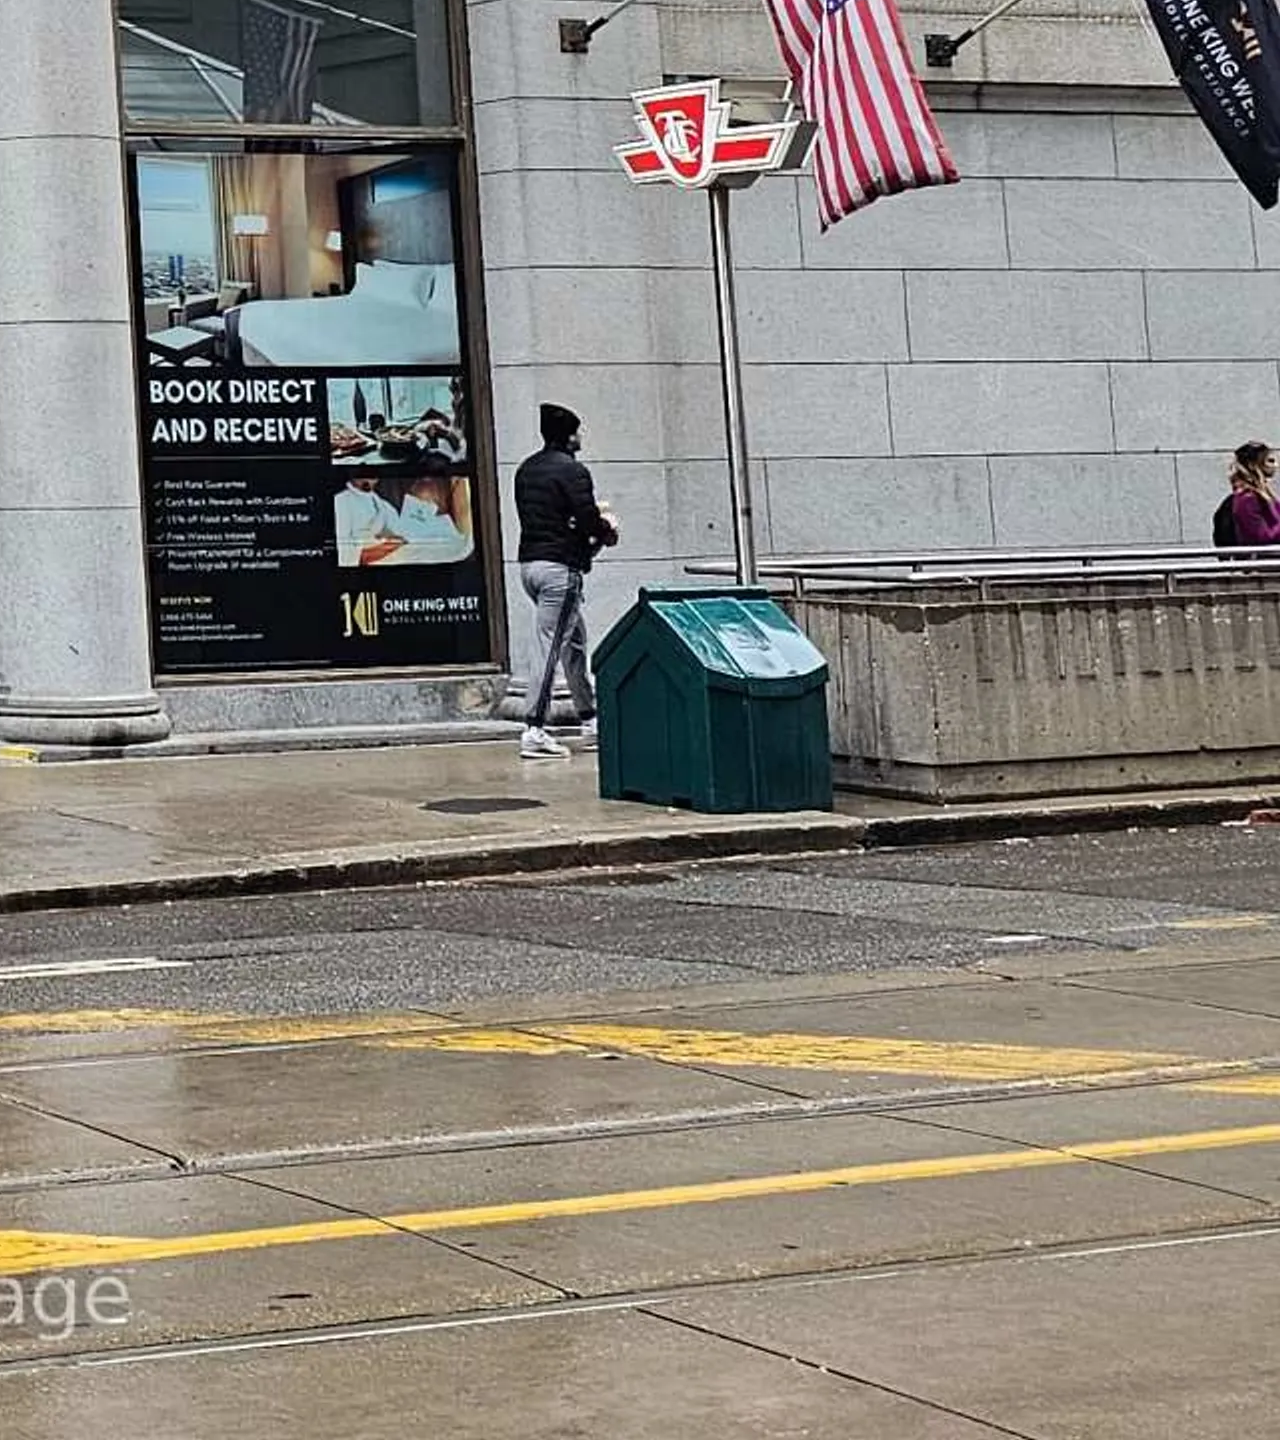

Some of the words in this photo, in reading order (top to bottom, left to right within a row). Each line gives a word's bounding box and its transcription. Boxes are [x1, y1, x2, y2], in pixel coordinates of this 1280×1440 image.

[1199, 27, 1239, 78] KING
[149, 379, 223, 404] BOOK
[229, 379, 316, 403] DIRECT
[151, 418, 207, 443] AND
[214, 417, 317, 442] RECEIVE
[382, 598, 410, 613] ONE
[413, 597, 445, 612] KING
[447, 596, 479, 610] WEST
